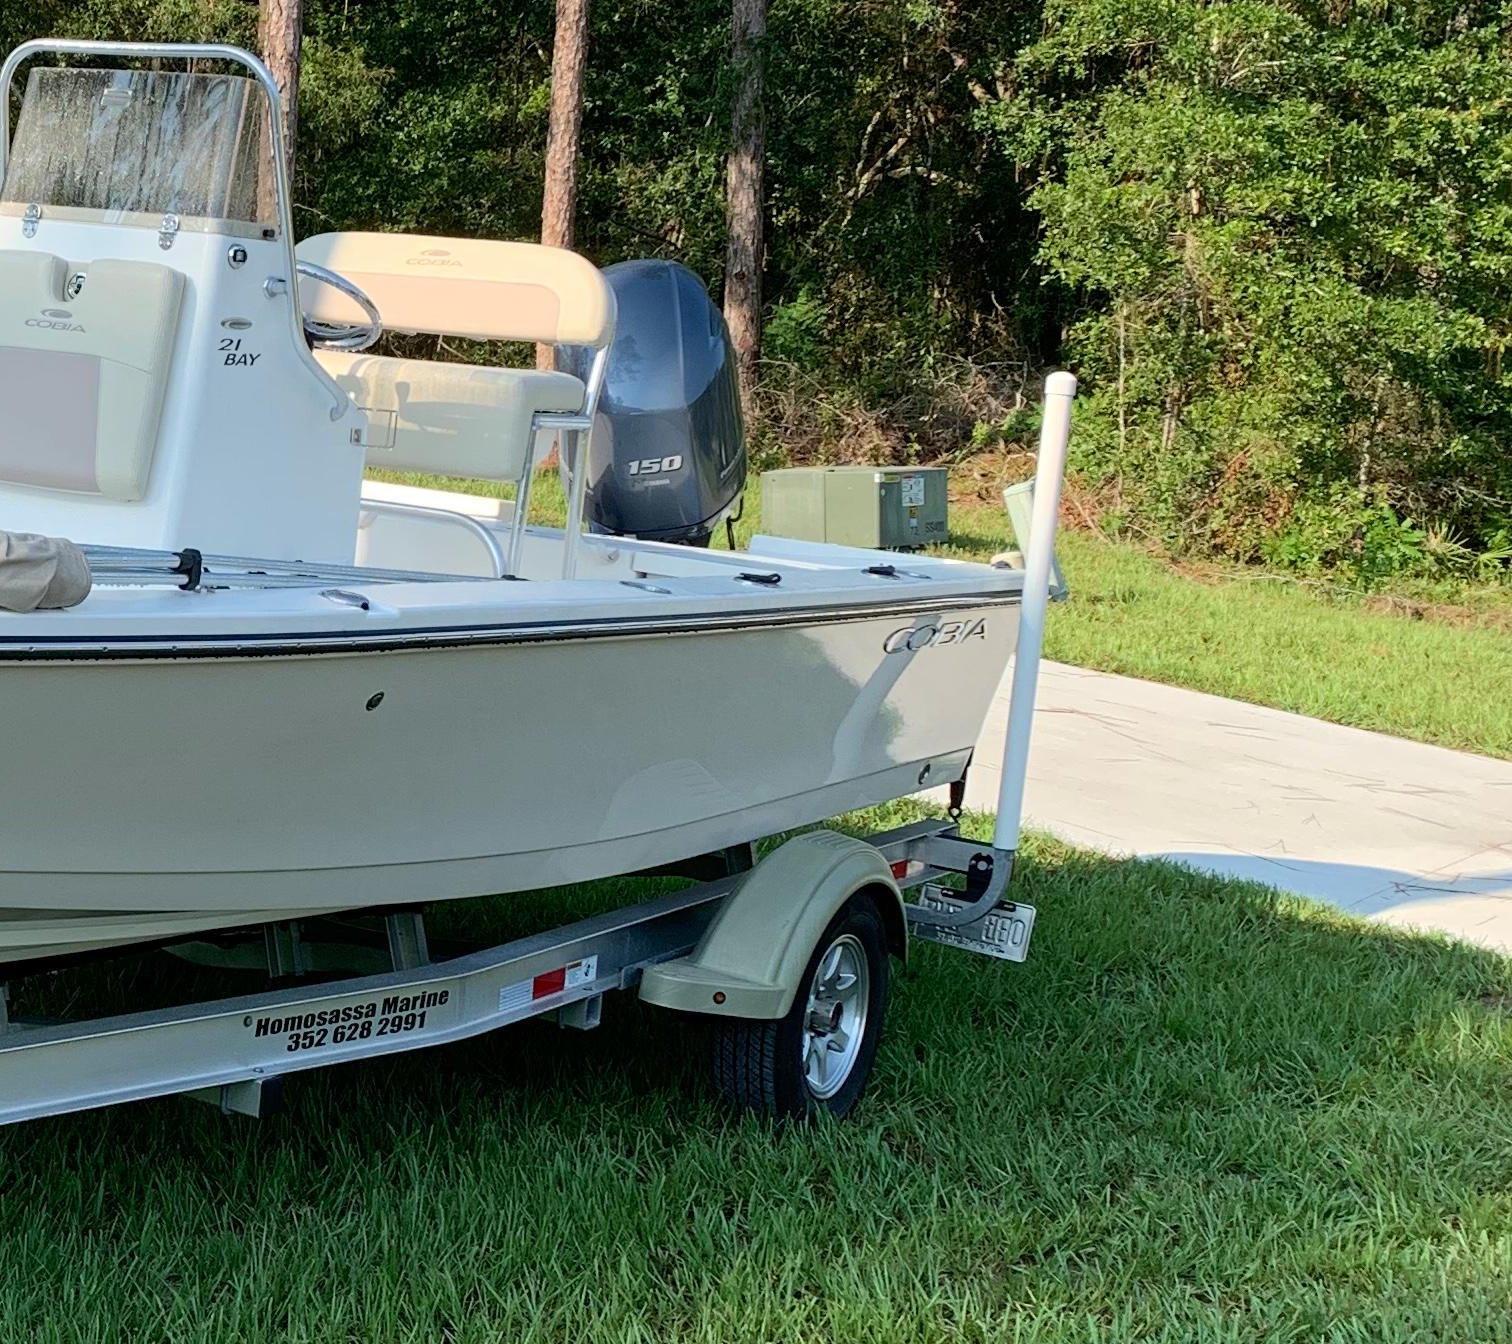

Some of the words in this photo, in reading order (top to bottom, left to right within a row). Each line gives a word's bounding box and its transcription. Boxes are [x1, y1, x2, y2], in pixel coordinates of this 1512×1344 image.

[24, 318, 86, 334] COBIA
[217, 338, 242, 352] 21
[223, 353, 262, 367] BAY
[628, 454, 684, 476] 150
[883, 617, 986, 654] COBIA
[254, 1002, 377, 1038] Homosassa
[381, 989, 450, 1016] Marine
[286, 1027, 329, 1052] 352
[332, 1020, 373, 1044] 628
[376, 1010, 428, 1037] 2991
